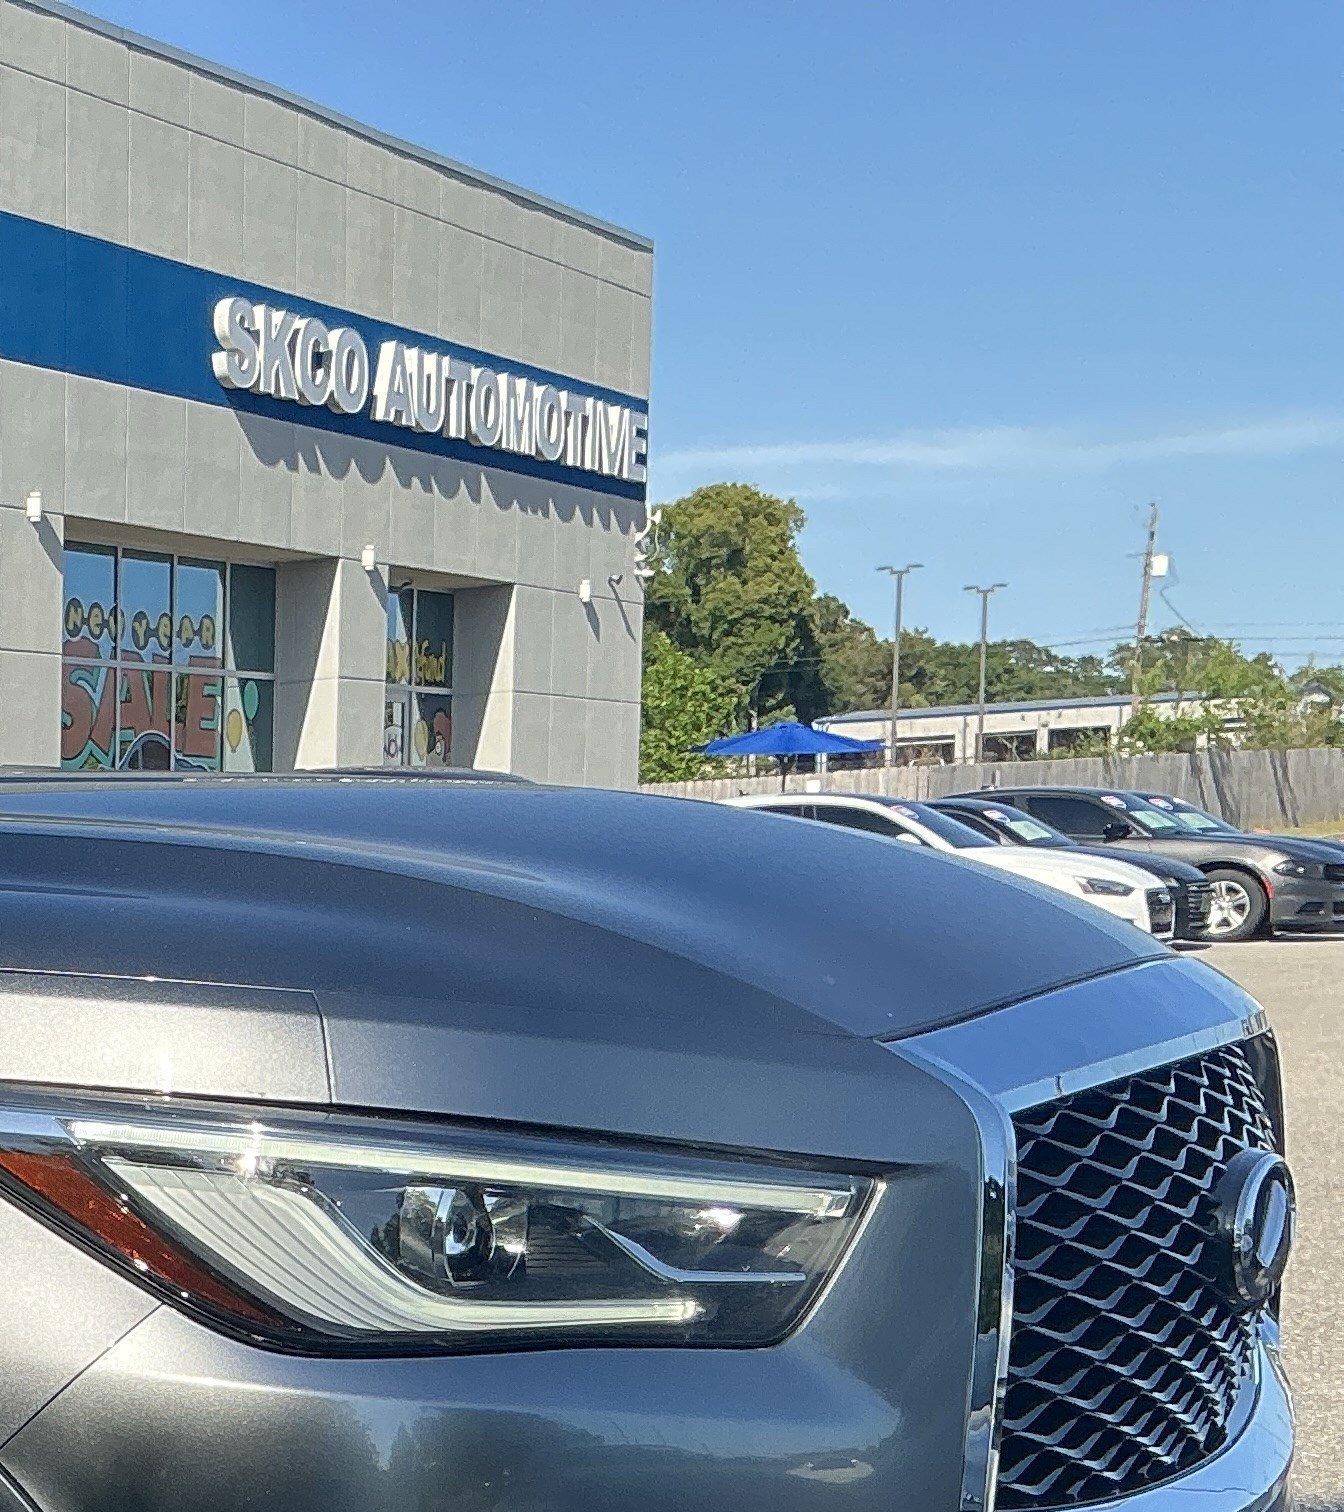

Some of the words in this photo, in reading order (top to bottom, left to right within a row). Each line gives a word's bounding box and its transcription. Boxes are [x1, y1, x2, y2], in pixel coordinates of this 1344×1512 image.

[212, 297, 369, 415] SKCO
[374, 339, 648, 482] AUTOMOTIVE
[62, 636, 222, 760] SALE
